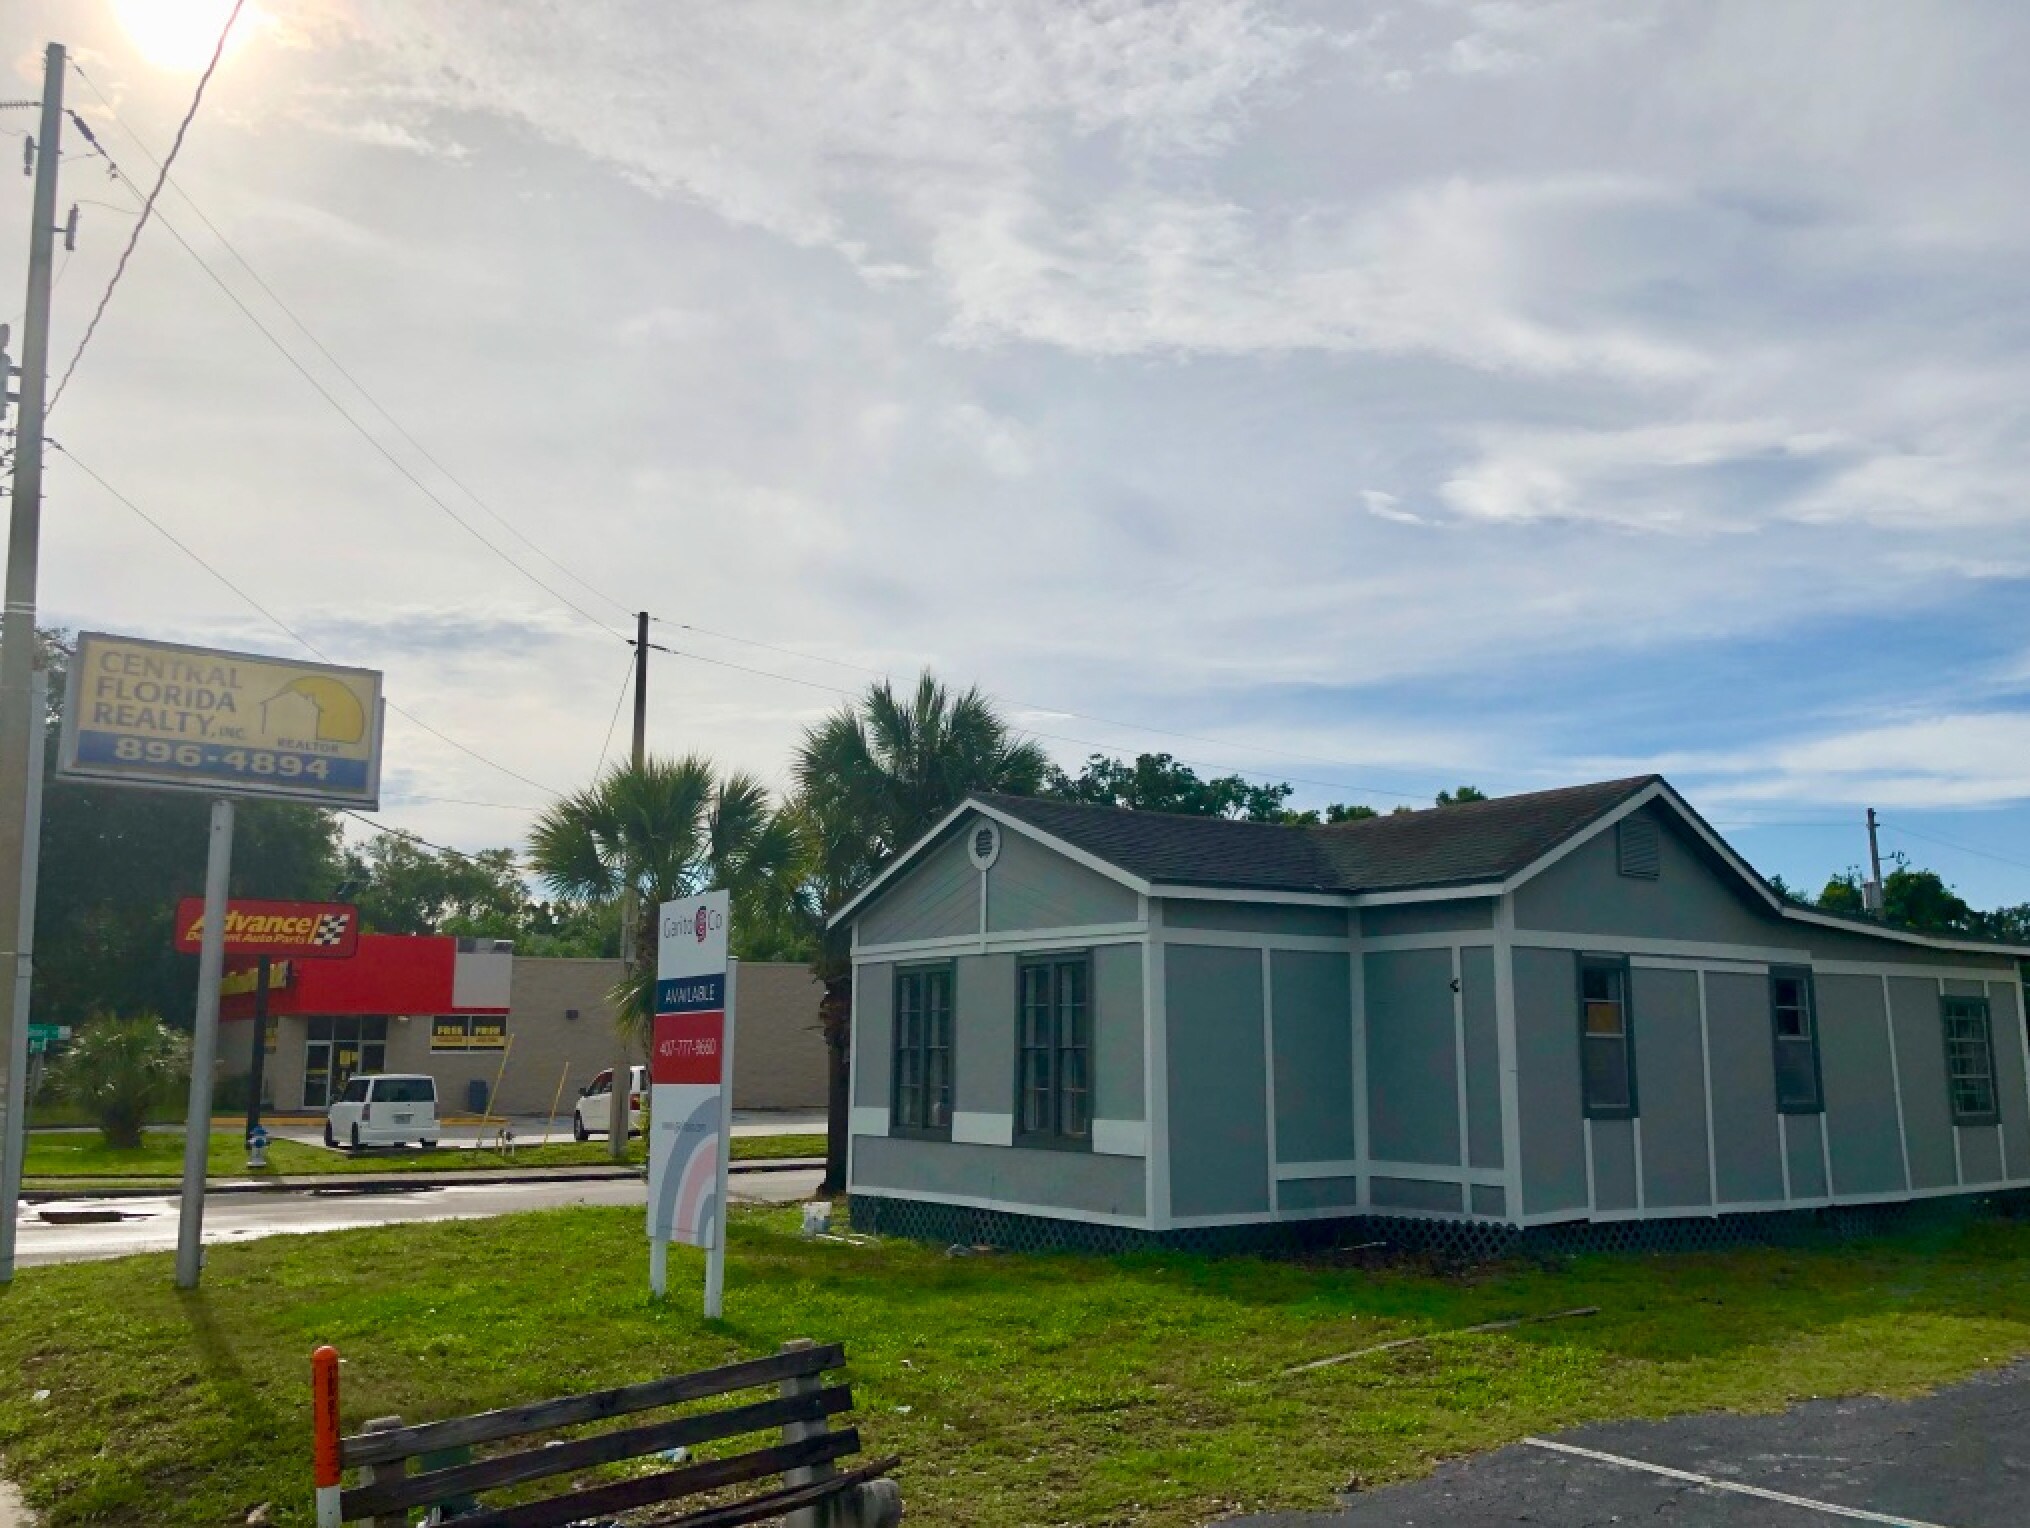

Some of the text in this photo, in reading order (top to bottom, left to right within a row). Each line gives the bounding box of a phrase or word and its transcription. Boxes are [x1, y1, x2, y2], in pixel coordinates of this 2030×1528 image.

[101, 651, 242, 689] CENTRAL
[97, 675, 236, 713] FLORIDA
[115, 737, 329, 781] 896-4894
[665, 984, 715, 1004] AVAILABLE
